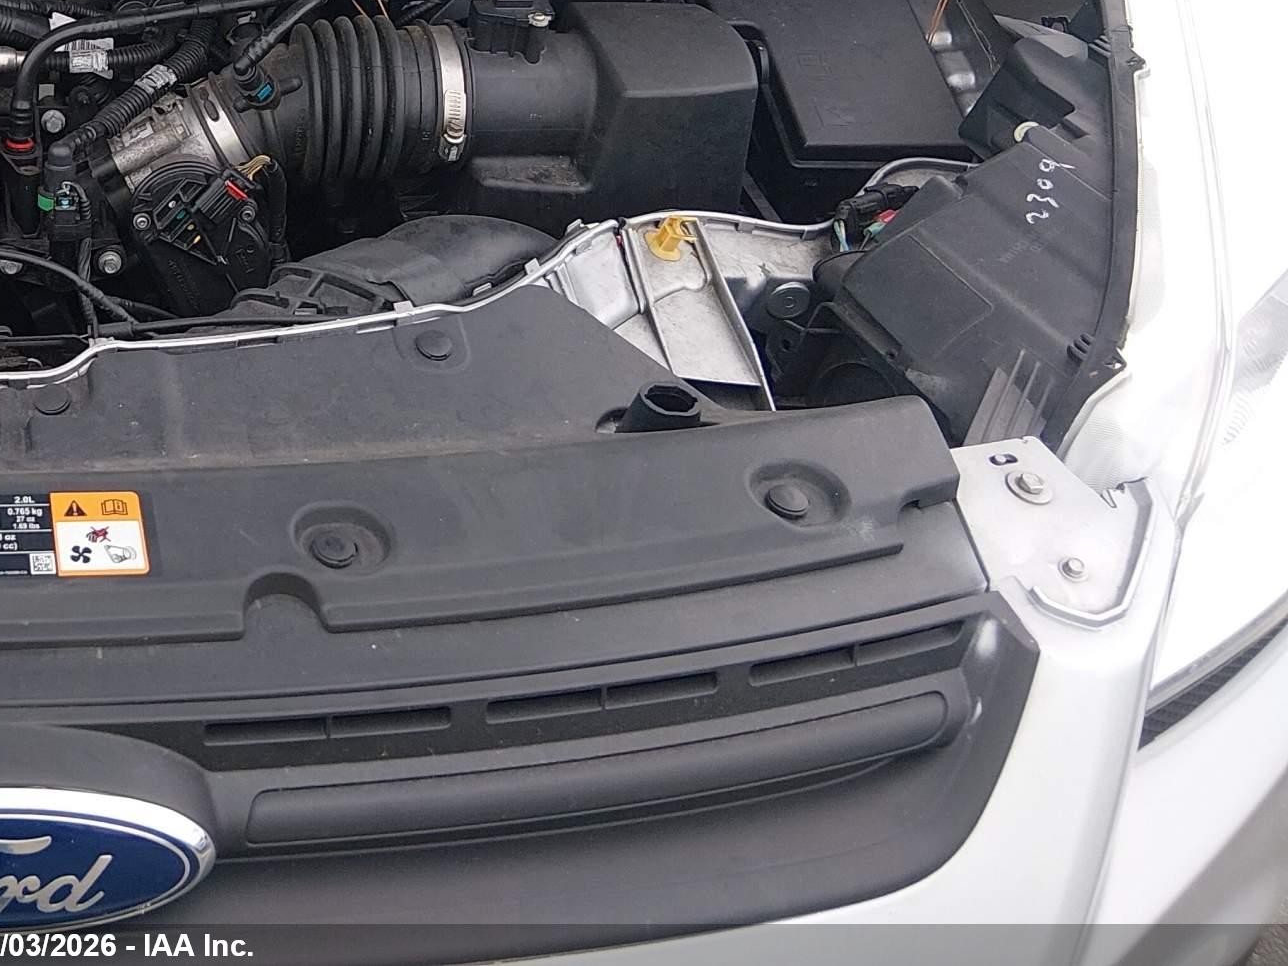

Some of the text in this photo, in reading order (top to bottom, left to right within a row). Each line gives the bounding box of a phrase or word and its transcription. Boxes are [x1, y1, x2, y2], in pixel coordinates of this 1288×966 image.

[14, 496, 35, 504] 2.0L
[7, 507, 43, 517] 0.765 kg
[28, 522, 40, 530] lbs
[4, 533, 16, 541] oz
[2, 541, 18, 551] cc)
